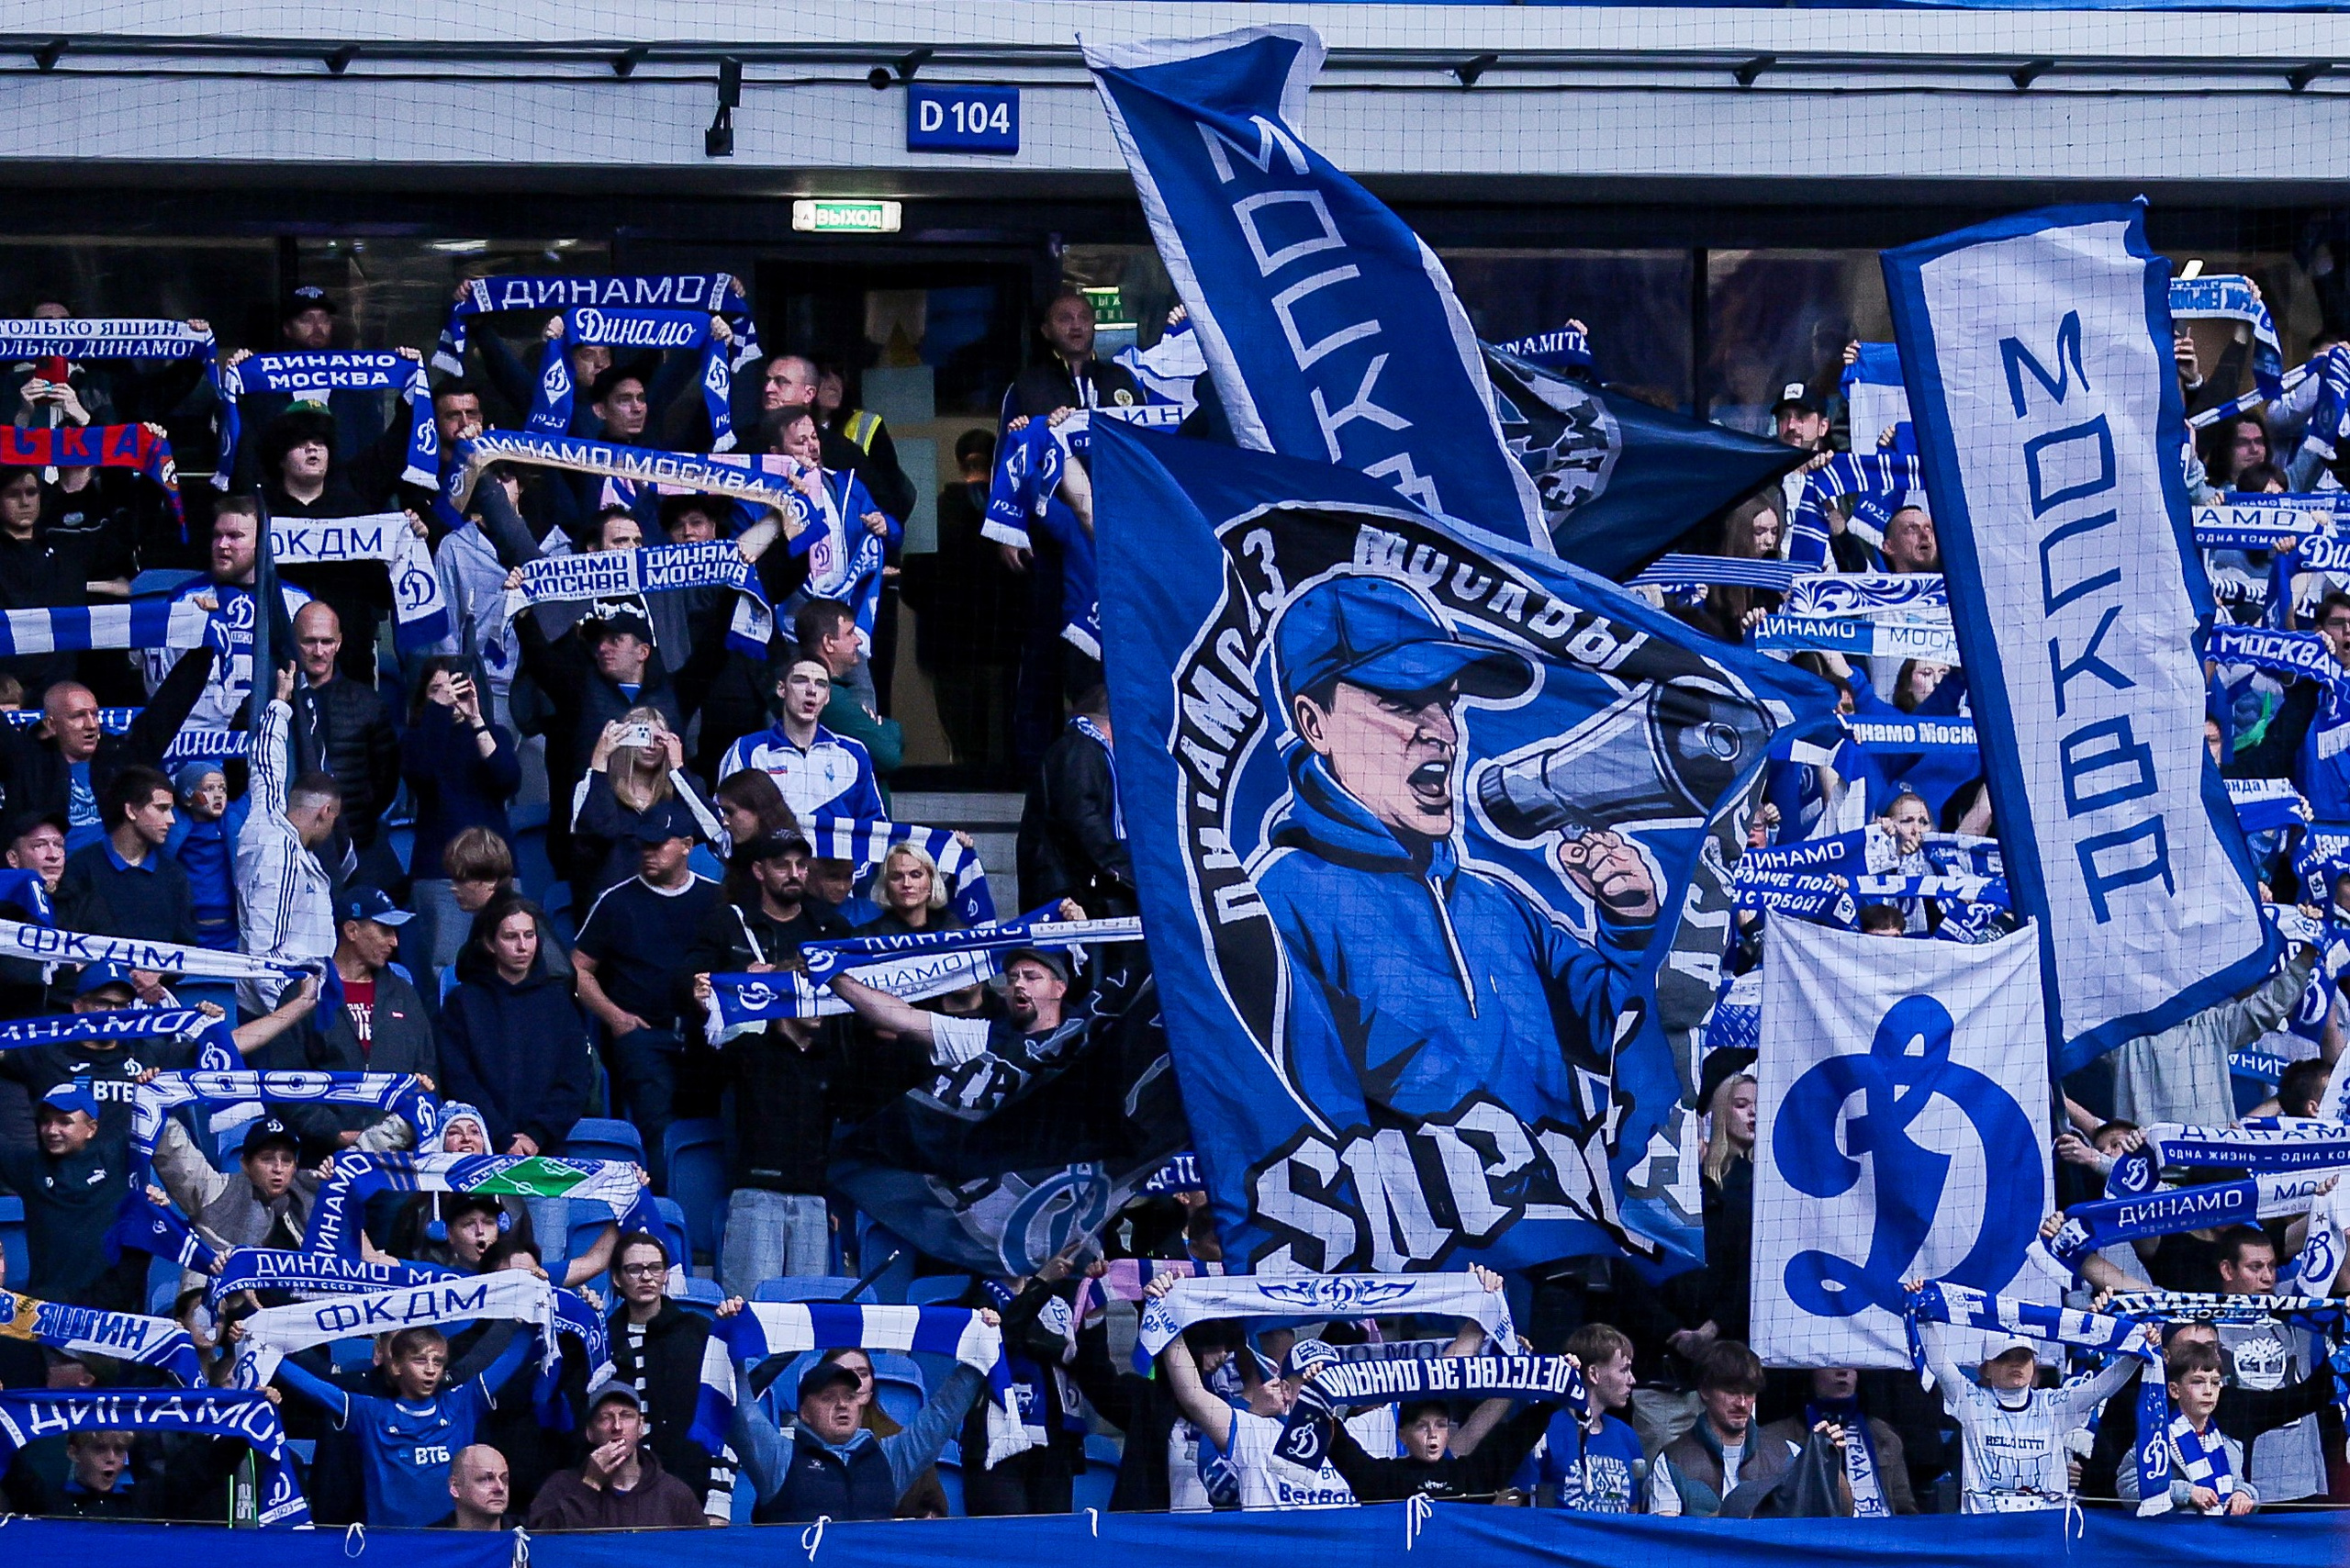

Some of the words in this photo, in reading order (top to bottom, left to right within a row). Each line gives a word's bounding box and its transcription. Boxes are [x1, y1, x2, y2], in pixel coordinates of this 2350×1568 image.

[919, 100, 944, 132] D
[950, 101, 1011, 134] 104
[815, 207, 882, 228] ВЫХОД
[501, 275, 706, 309] ДИНАМО
[576, 308, 697, 347] Динамо
[261, 354, 397, 371] ДИНАМО
[268, 371, 390, 388] МОСКВА
[714, 414, 731, 429] 192
[471, 433, 612, 469] ДИНАМО
[624, 456, 765, 495] МОСКВА
[1754, 618, 1856, 640] ДИНАМО
[2220, 632, 2333, 678] МОСКВА
[1738, 841, 1845, 870] ДИНАМО
[17, 924, 185, 970] ФКДМ
[2209, 1148, 2256, 1162] ЖИЗНЬ
[2280, 1149, 2321, 1162] ОДНА
[2118, 1188, 2244, 1227] ДИНАМО
[256, 1253, 390, 1282] ДИНАМО
[315, 1283, 488, 1332] ФКДМ
[32, 1304, 150, 1352] ЯШИН
[29, 1395, 276, 1442] ДИНАМО
[414, 1445, 451, 1466] ВТБ
